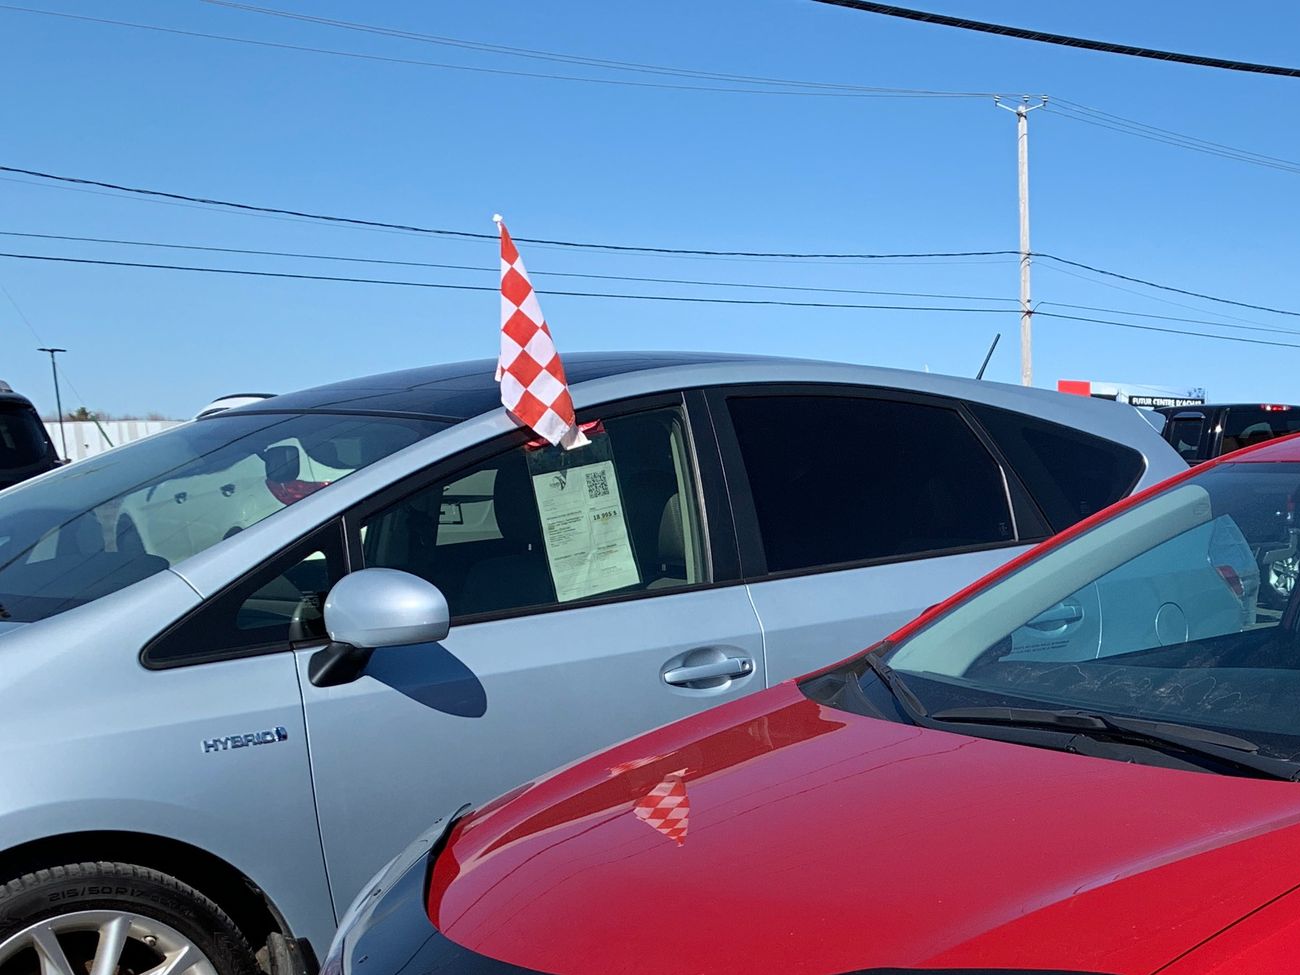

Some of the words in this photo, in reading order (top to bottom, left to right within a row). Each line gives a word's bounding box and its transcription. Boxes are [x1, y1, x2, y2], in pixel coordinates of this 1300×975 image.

[1132, 397, 1152, 405] FUTUR
[1153, 398, 1175, 406] CENTRE
[201, 731, 276, 753] HYBRID
